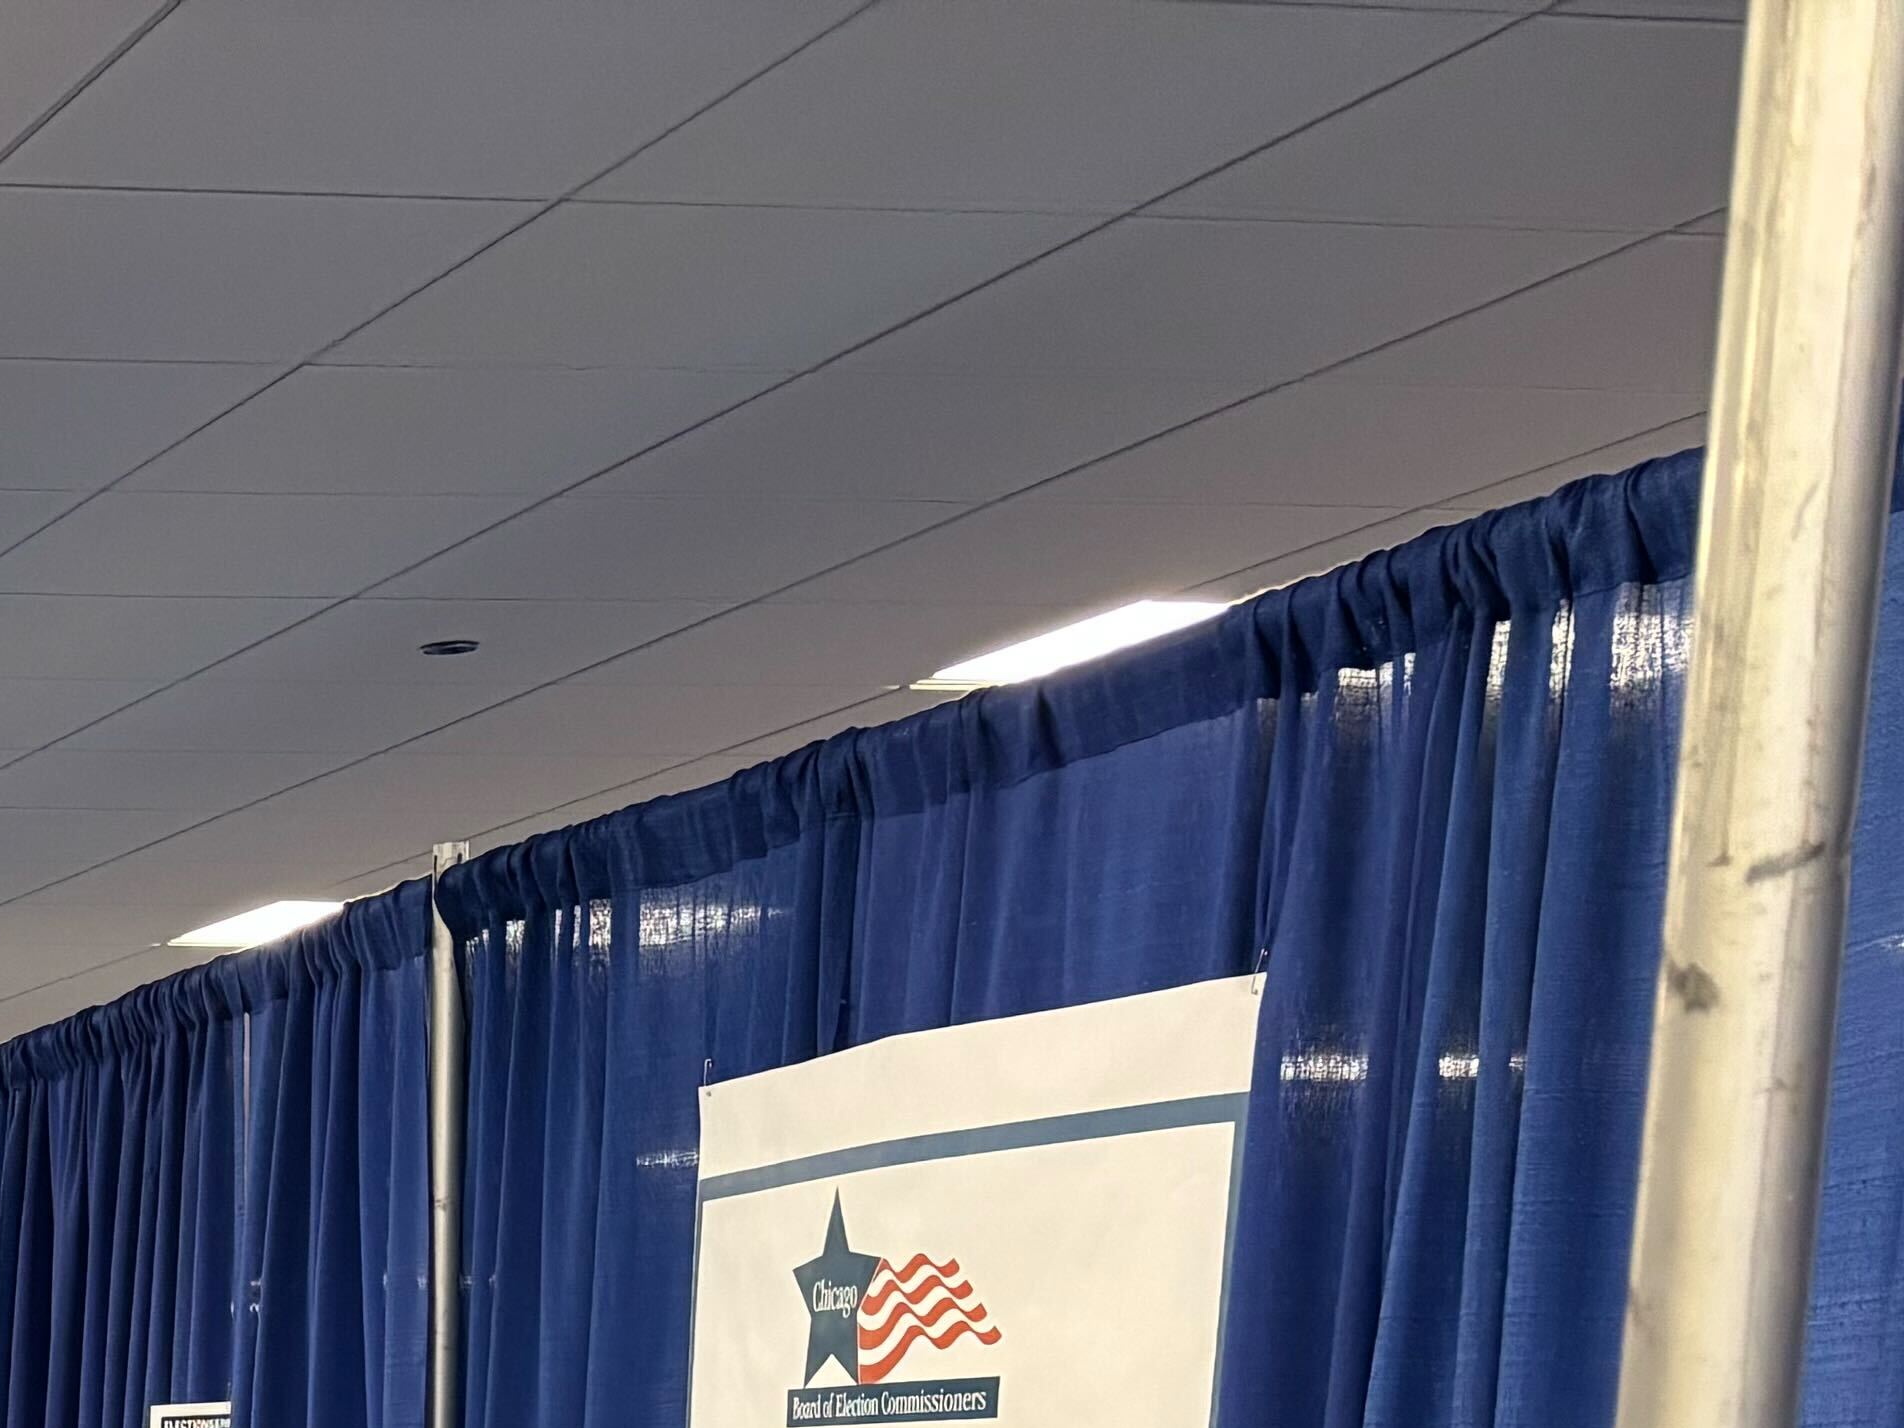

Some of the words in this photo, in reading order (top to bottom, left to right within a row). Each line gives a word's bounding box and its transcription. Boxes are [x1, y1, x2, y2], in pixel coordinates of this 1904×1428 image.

[813, 1278, 858, 1319] Chicago
[792, 1392, 821, 1420] Board
[823, 1392, 835, 1418] of
[836, 1392, 879, 1418] Election
[881, 1388, 987, 1416] Commissioners
